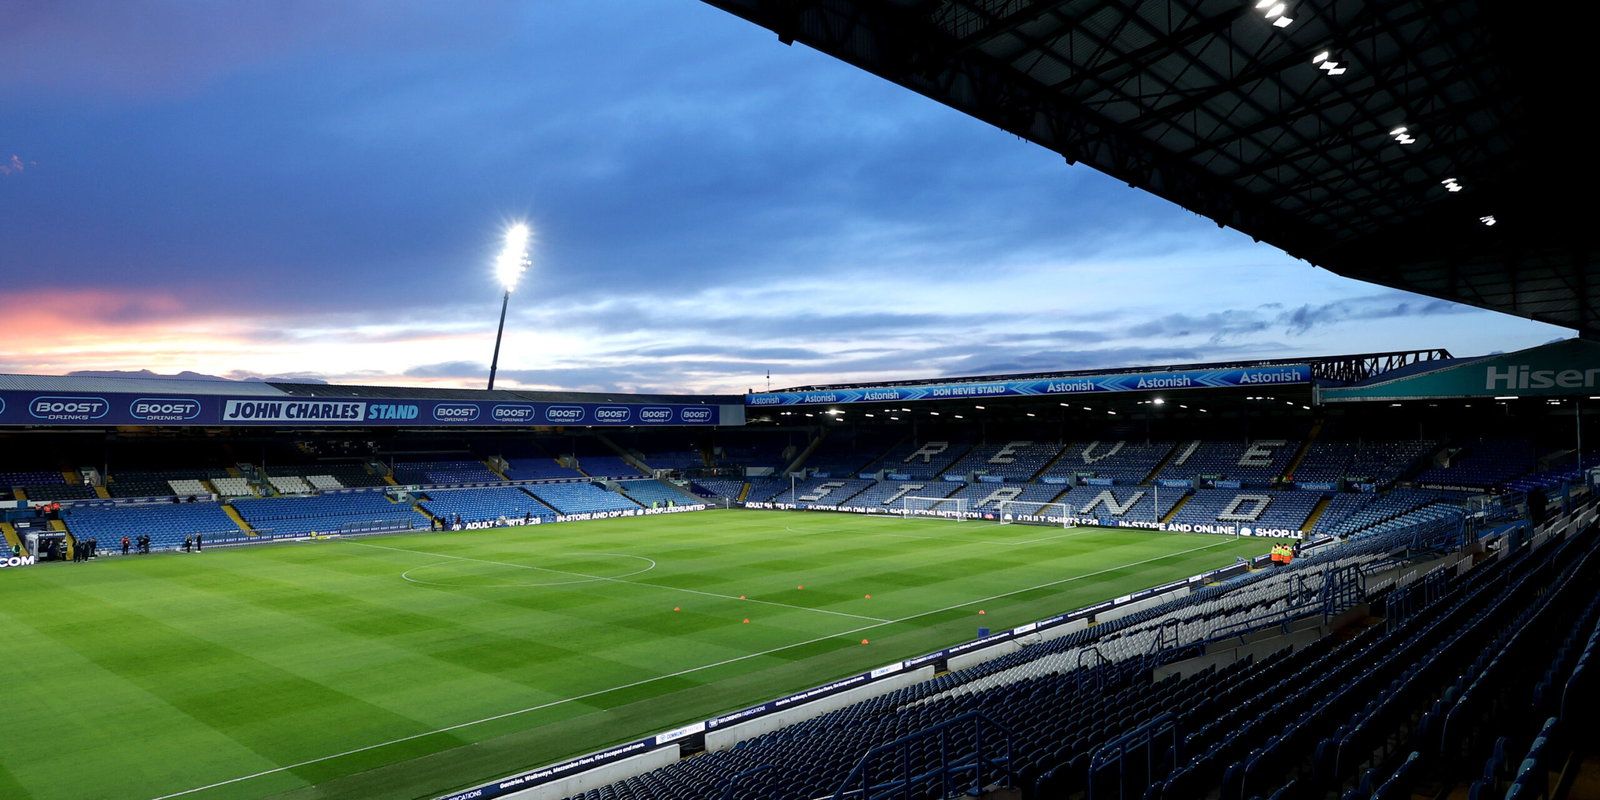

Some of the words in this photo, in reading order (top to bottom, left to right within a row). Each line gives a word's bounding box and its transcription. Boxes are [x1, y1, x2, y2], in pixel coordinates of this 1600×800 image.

[1239, 369, 1301, 384] Astonish
[1047, 381, 1095, 393] Astonish
[1137, 375, 1191, 389] Astonish
[864, 390, 899, 401] Astonish
[933, 388, 951, 396] DON
[953, 387, 976, 395] REVIE
[977, 386, 1005, 394] STAND
[751, 397, 779, 405] Astonish
[804, 394, 836, 403] Astonish
[36, 403, 103, 413] BOOST
[136, 404, 196, 414] BOOST
[229, 402, 282, 419] JOHN
[285, 403, 360, 420] CHARLES
[367, 404, 419, 420] STAND
[437, 408, 476, 416] BOOST
[495, 409, 531, 417] BOOST
[549, 410, 582, 418] BOOST
[597, 410, 628, 418] BOOST
[642, 410, 670, 418] BOOST
[465, 520, 494, 530] ADULT
[496, 518, 526, 528] SIRTS
[556, 513, 591, 522] IN-STORE
[591, 512, 608, 520] AND
[1167, 523, 1192, 532] AND
[1193, 524, 1236, 535] ONLINE
[1255, 527, 1303, 540] SHOP.LE
[499, 778, 524, 789] Gantries,
[524, 770, 552, 782] Walkways,
